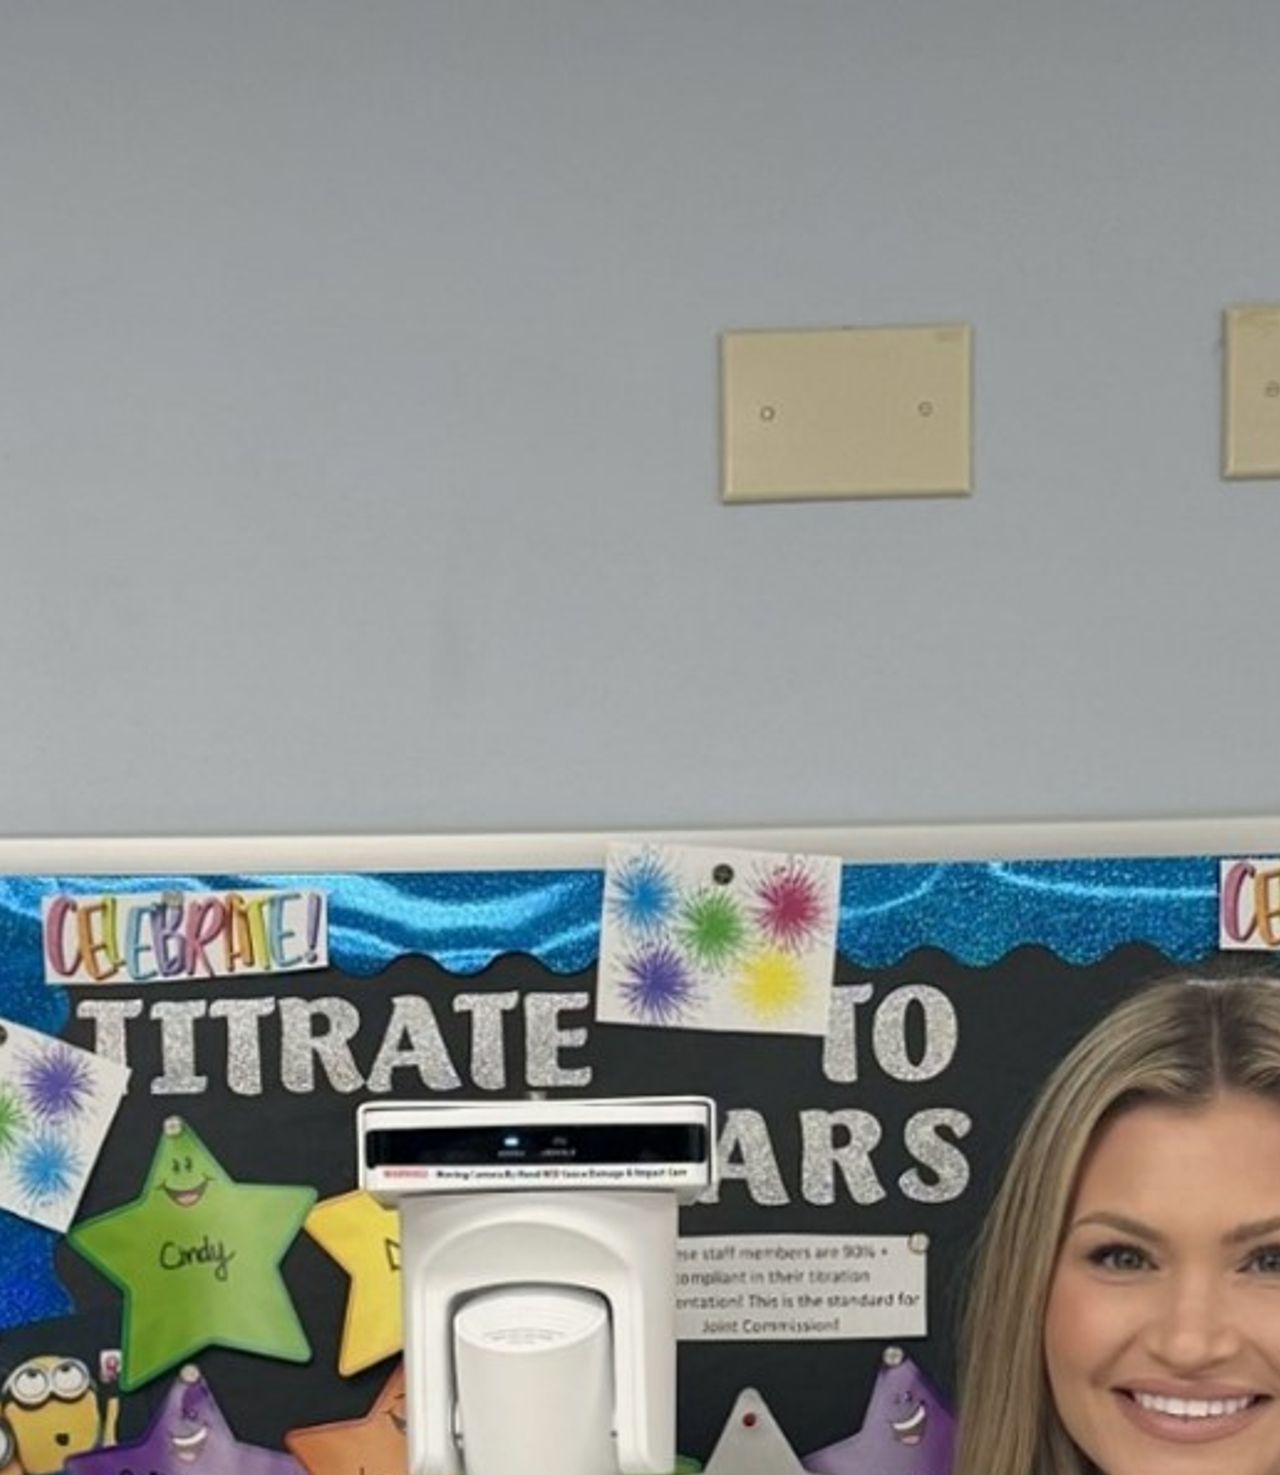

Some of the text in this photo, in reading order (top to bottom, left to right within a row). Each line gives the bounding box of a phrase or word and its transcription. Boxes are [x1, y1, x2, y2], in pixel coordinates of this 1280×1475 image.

[44, 891, 322, 979] CELEBRATE!
[76, 990, 593, 1097] TITRATE
[822, 983, 959, 1083] TO
[738, 1245, 811, 1260] members
[768, 1269, 804, 1282] their
[748, 1293, 778, 1309] This
[800, 1293, 823, 1308] the
[826, 1292, 894, 1308] standard
[702, 1318, 738, 1333] Joint
